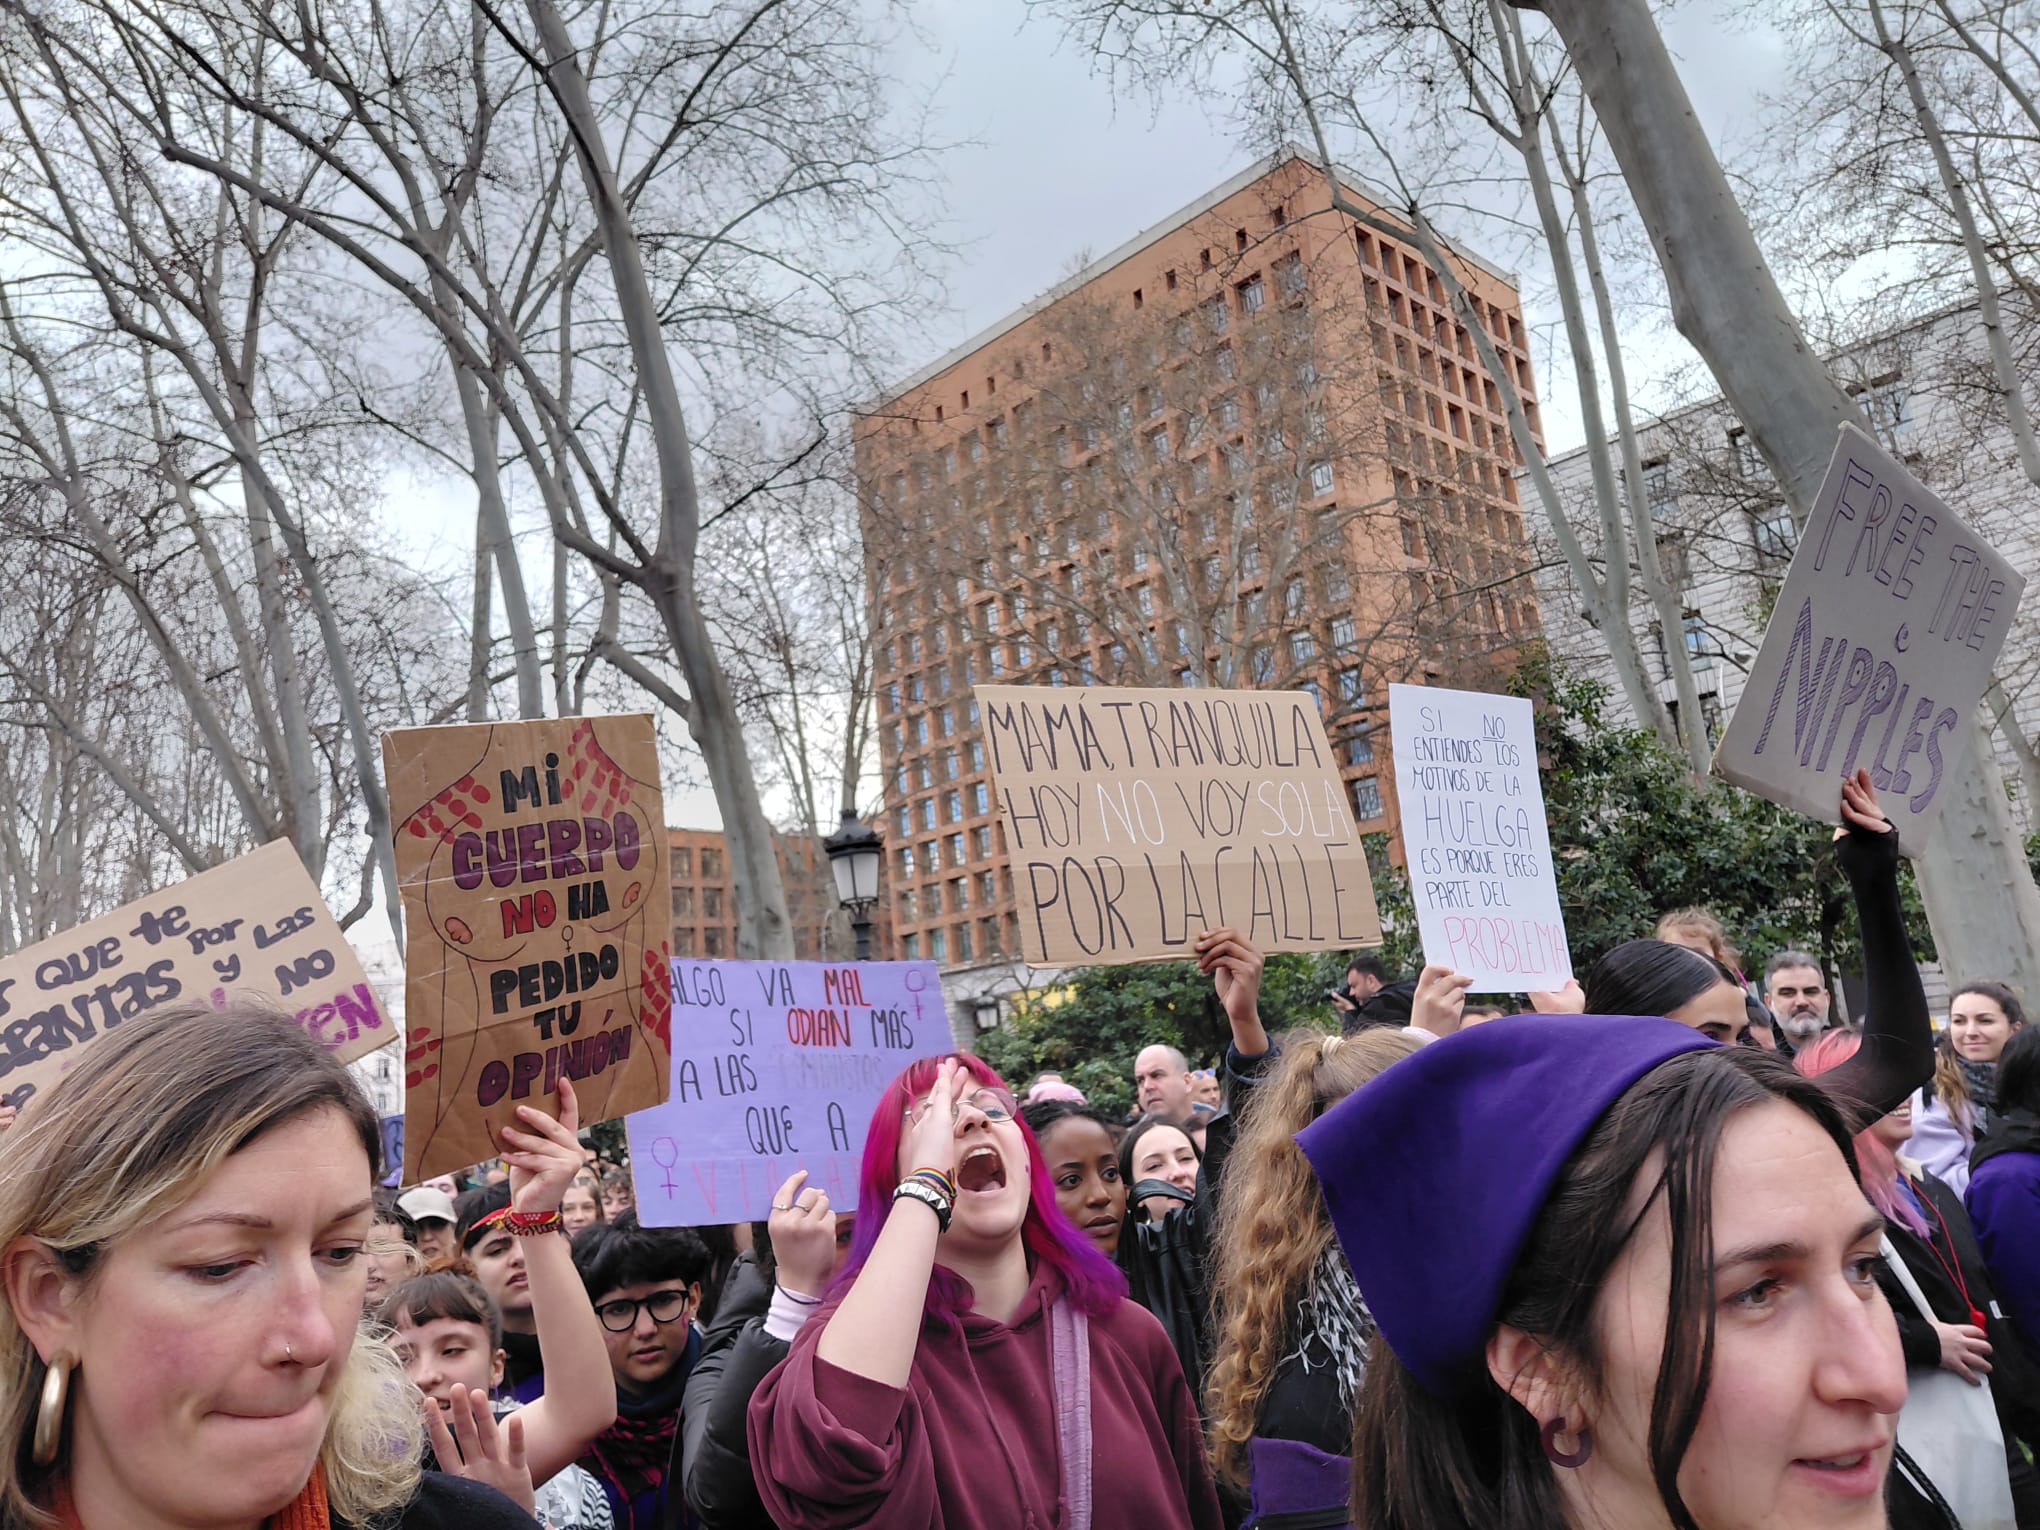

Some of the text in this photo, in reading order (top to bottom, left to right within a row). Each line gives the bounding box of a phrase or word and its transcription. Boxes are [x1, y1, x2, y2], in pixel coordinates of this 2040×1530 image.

[1814, 458, 2005, 652] FREE THE
[1420, 707, 1506, 739] SI NO
[1754, 596, 1959, 814] NIPPLES
[987, 692, 1322, 774] MAMÁ, TRANQUILA
[1413, 736, 1520, 767] ENTIENDES LOS
[1412, 766, 1522, 796] MOTIVOS DE LA
[1004, 779, 1351, 849] HOY NO VOY SOLA
[1423, 796, 1532, 850] HUELGA
[452, 811, 640, 891] CUERPO
[1420, 848, 1539, 877] ES PORQUE ERES
[500, 880, 610, 938] NO HA
[1028, 843, 1364, 961] POR LA CALLE
[1425, 880, 1511, 910] PARTE DEL
[1443, 916, 1569, 974] PROBLEMA
[275, 949, 335, 995] NO
[490, 944, 619, 1014] PEDIDO
[670, 967, 872, 1008] ALGO VA MAL
[533, 1000, 581, 1041] TU
[730, 1003, 914, 1049] SI ODIAN MÁS
[477, 1009, 633, 1107] OPINIÓN
[679, 1059, 703, 1103] A
[714, 1055, 758, 1096] LAS
[827, 1102, 850, 1152] A
